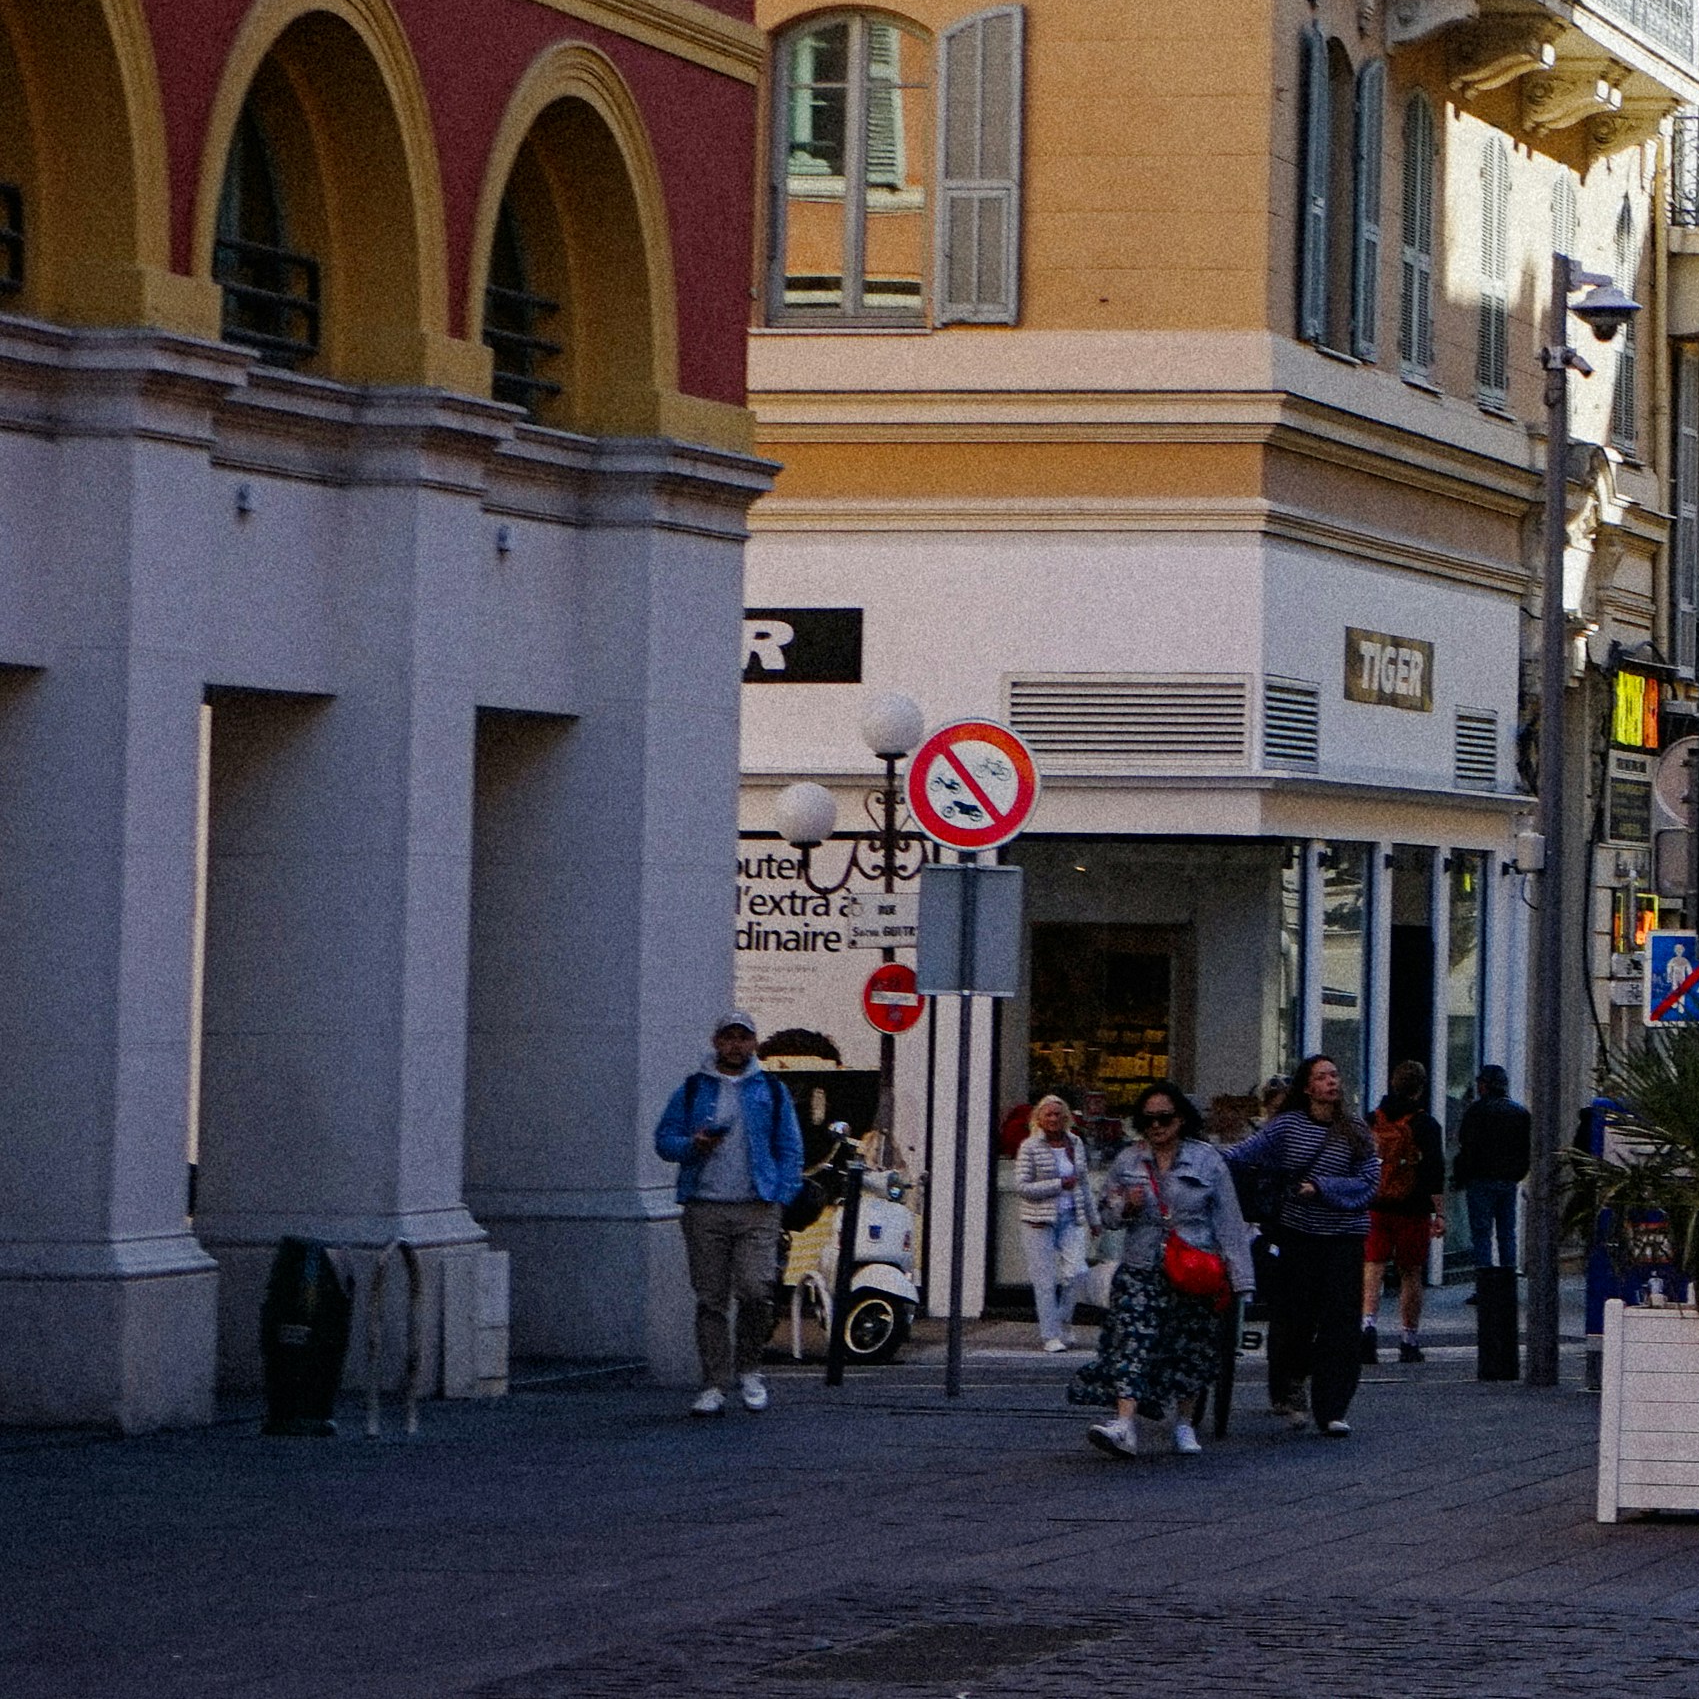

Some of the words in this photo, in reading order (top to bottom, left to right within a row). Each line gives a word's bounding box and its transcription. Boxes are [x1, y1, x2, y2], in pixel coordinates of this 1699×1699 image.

[741, 620, 794, 670] R
[1360, 640, 1424, 697] TIGER
[737, 885, 831, 916] l'extra
[736, 921, 842, 952] dinaire
